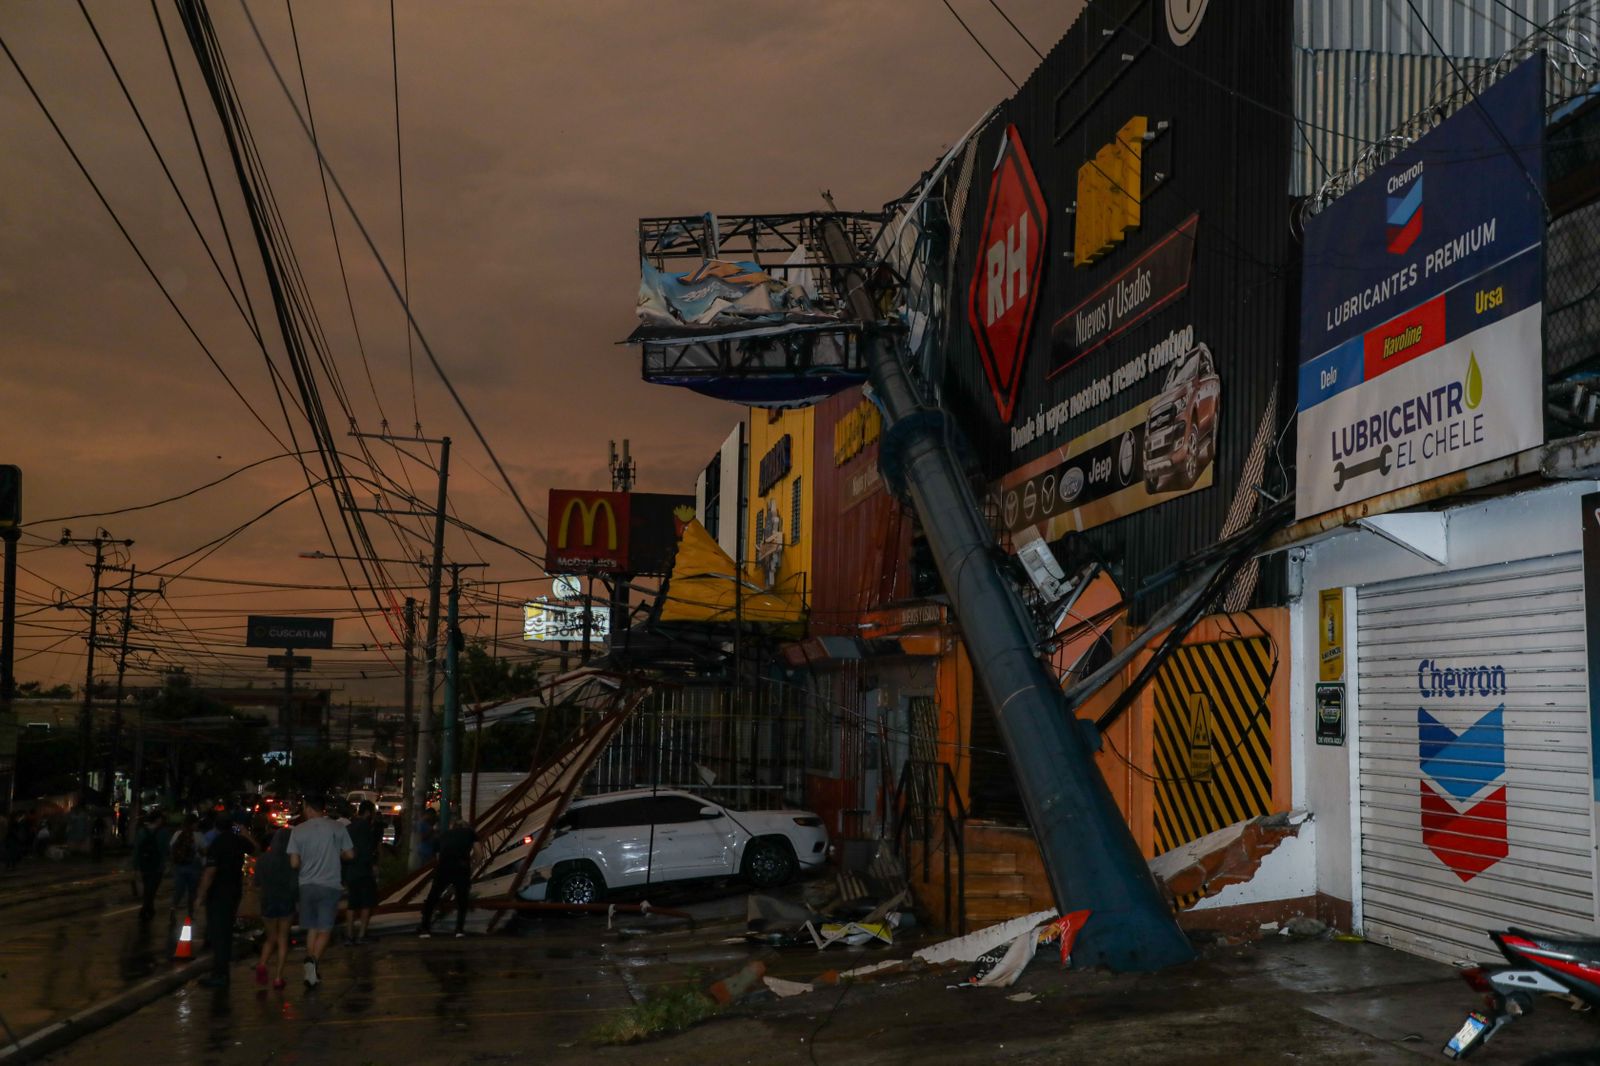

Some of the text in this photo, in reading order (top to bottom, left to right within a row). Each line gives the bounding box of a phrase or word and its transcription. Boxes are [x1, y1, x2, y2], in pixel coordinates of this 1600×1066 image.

[1387, 160, 1423, 194] Chevron
[986, 213, 1027, 327] RH
[1327, 218, 1496, 331] LUBRICANTES PREMIUM
[1075, 268, 1151, 347] Nuevos y Usados
[1475, 286, 1503, 315] Ursa
[1383, 324, 1423, 359] Havoline
[1011, 416, 1035, 452] Donde
[1046, 400, 1069, 436] vayas
[1070, 375, 1111, 418] nosotros
[1112, 353, 1147, 395] iremos
[1148, 324, 1194, 373] contigo
[1320, 366, 1337, 390] Delo
[1397, 414, 1484, 469] EL CHELE
[1088, 456, 1112, 484] Jeep
[557, 557, 617, 568] McDonld's
[1418, 659, 1507, 698] Chevron
